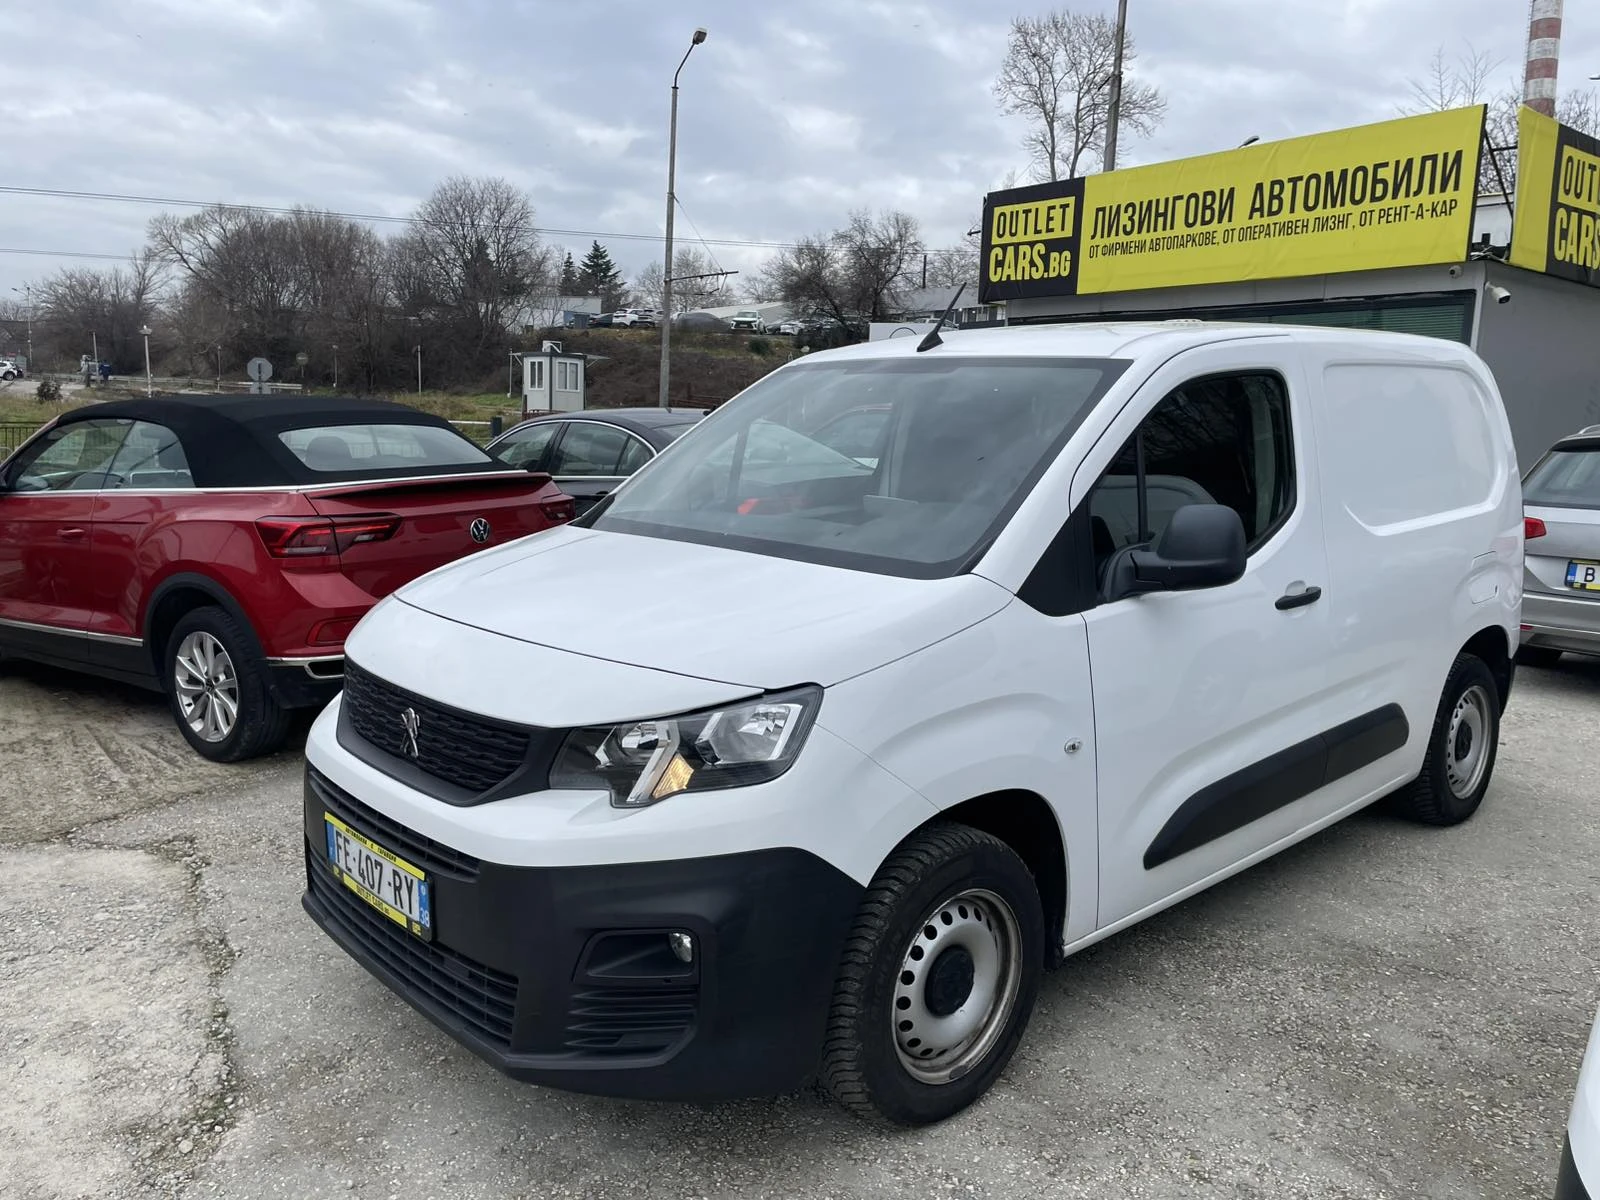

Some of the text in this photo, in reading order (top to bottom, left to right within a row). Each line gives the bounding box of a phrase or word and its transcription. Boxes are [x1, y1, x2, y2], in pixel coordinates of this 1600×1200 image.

[996, 202, 1070, 239] OUTLET
[1090, 149, 1463, 241] ЛИЗИНГОВИ АВТОМОБИЛИ
[1089, 244, 1101, 259] ОТ
[1101, 241, 1147, 257] ФИРМЕНИ
[1149, 230, 1220, 253] АВТОПАРКОВЕ,
[1223, 228, 1236, 244] ОТ
[1238, 219, 1308, 241] ОПЕРАТИВЕН
[1359, 209, 1375, 227] ОТ
[1378, 198, 1458, 225] РЕНТ-А-КАР
[988, 242, 1071, 283] CARS.BG
